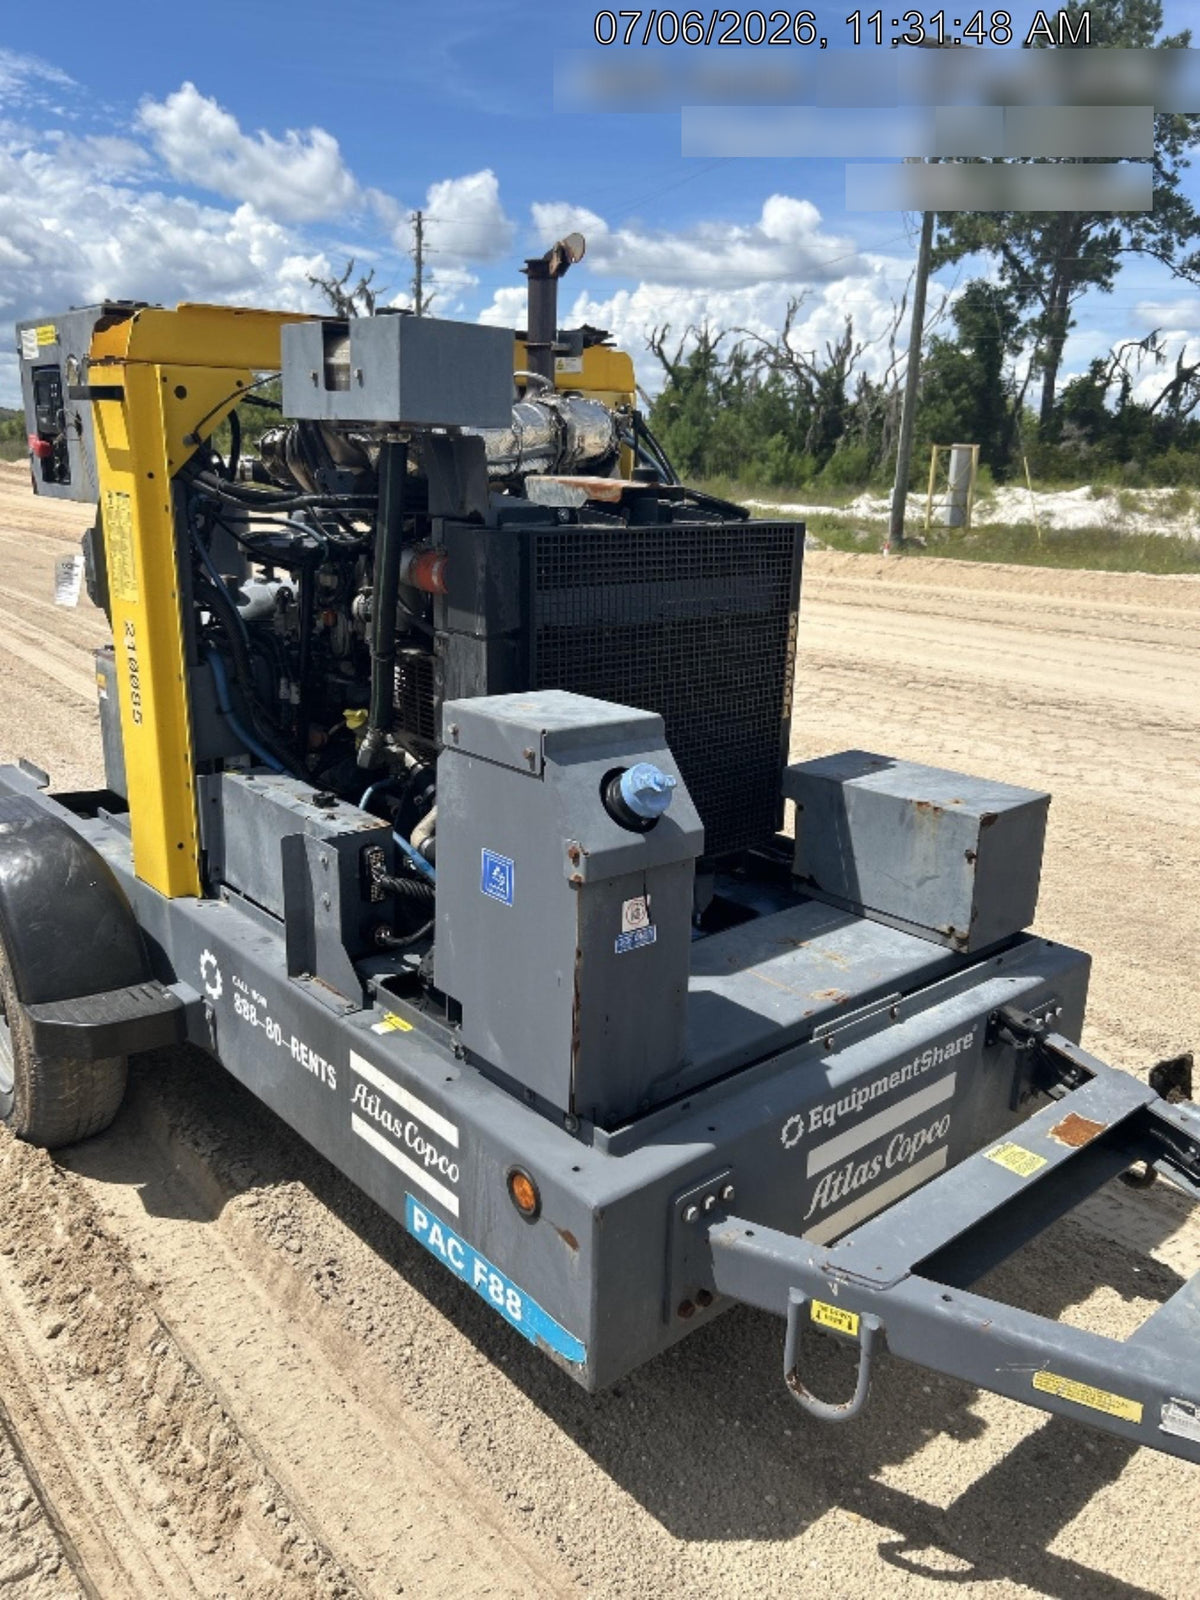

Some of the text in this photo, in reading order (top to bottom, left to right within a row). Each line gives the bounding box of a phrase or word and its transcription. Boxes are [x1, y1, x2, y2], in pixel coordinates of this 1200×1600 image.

[350, 1083, 460, 1183] Atlas Copco
[807, 1032, 974, 1133] EquipmentShare
[803, 1153, 884, 1220] Atlas
[884, 1113, 951, 1170] Copco
[413, 1205, 522, 1321] PAC F88
